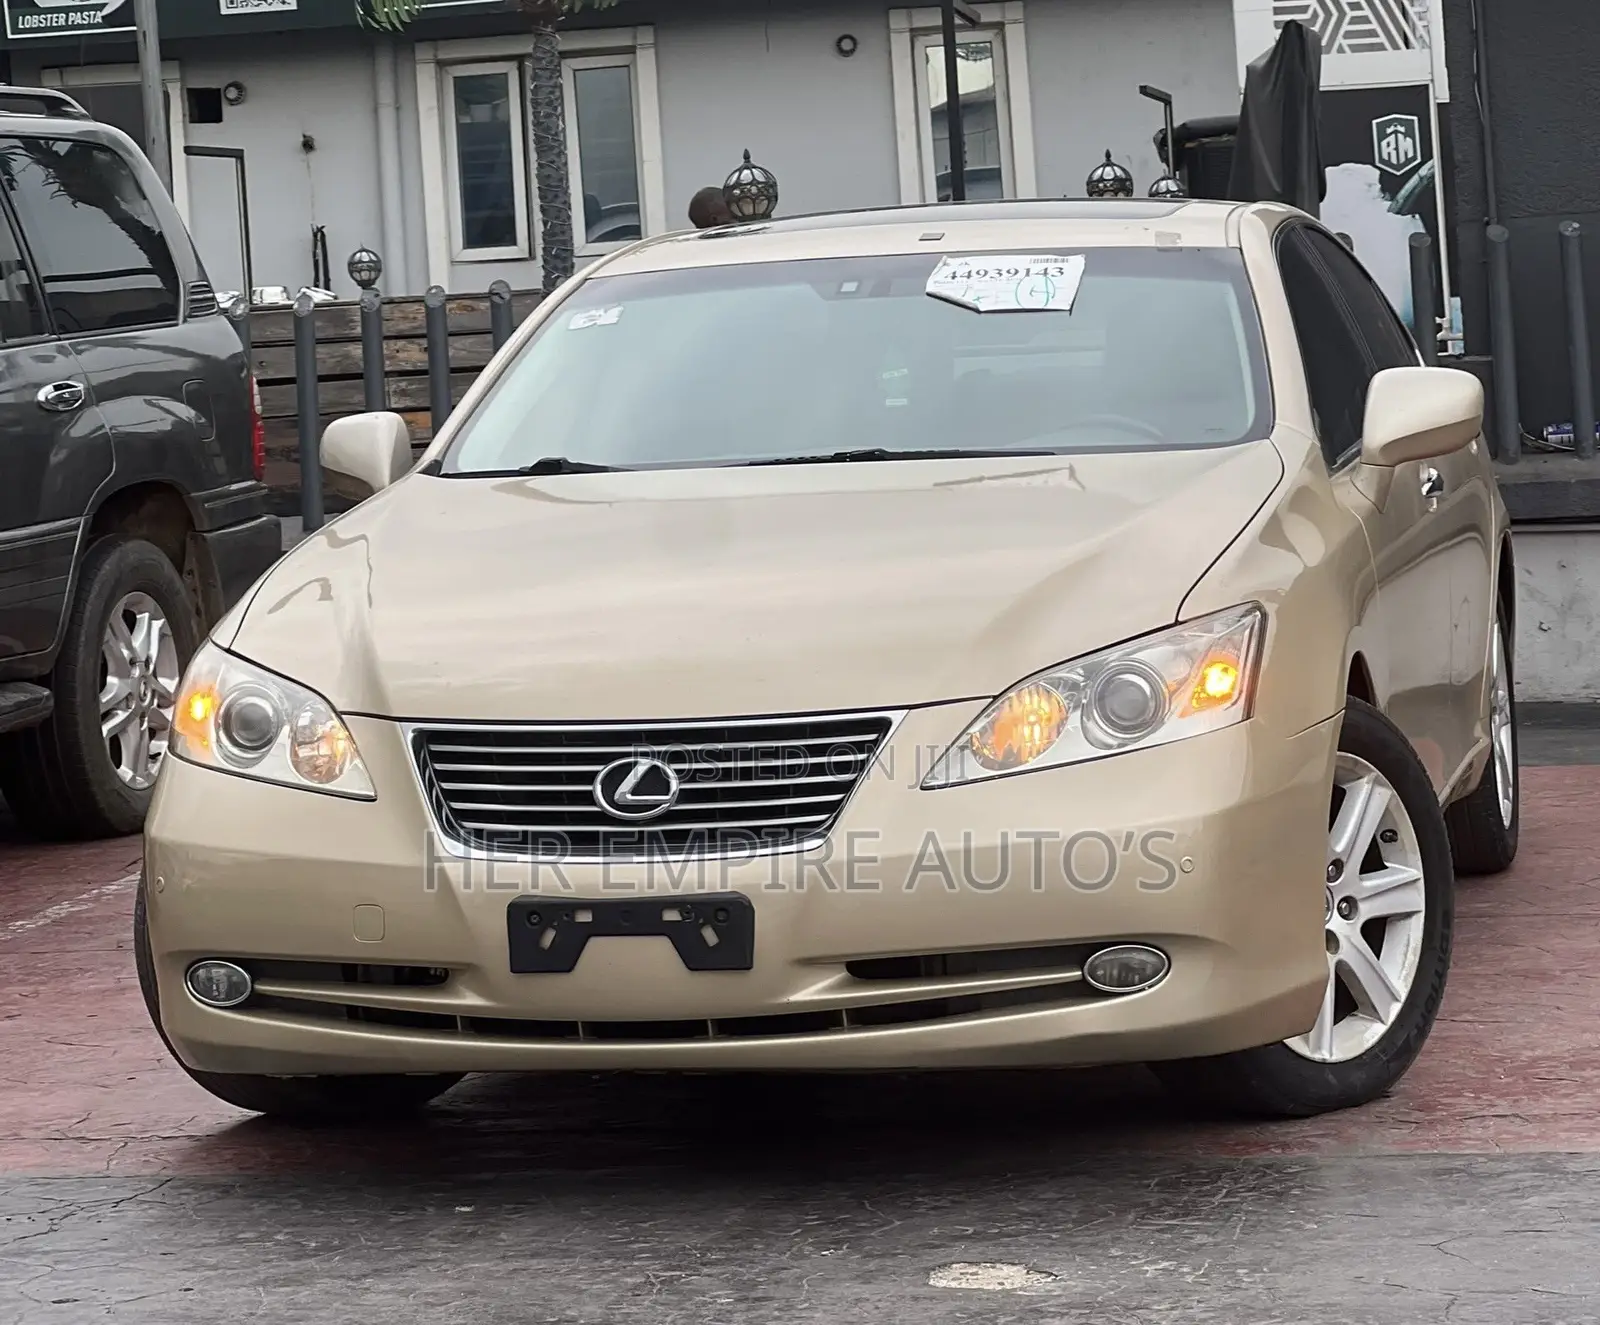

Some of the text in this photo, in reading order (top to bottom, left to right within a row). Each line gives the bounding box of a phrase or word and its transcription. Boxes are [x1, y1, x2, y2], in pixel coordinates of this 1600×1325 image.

[18, 11, 103, 28] LOBSTER PASTA
[944, 266, 1065, 281] 44939143
